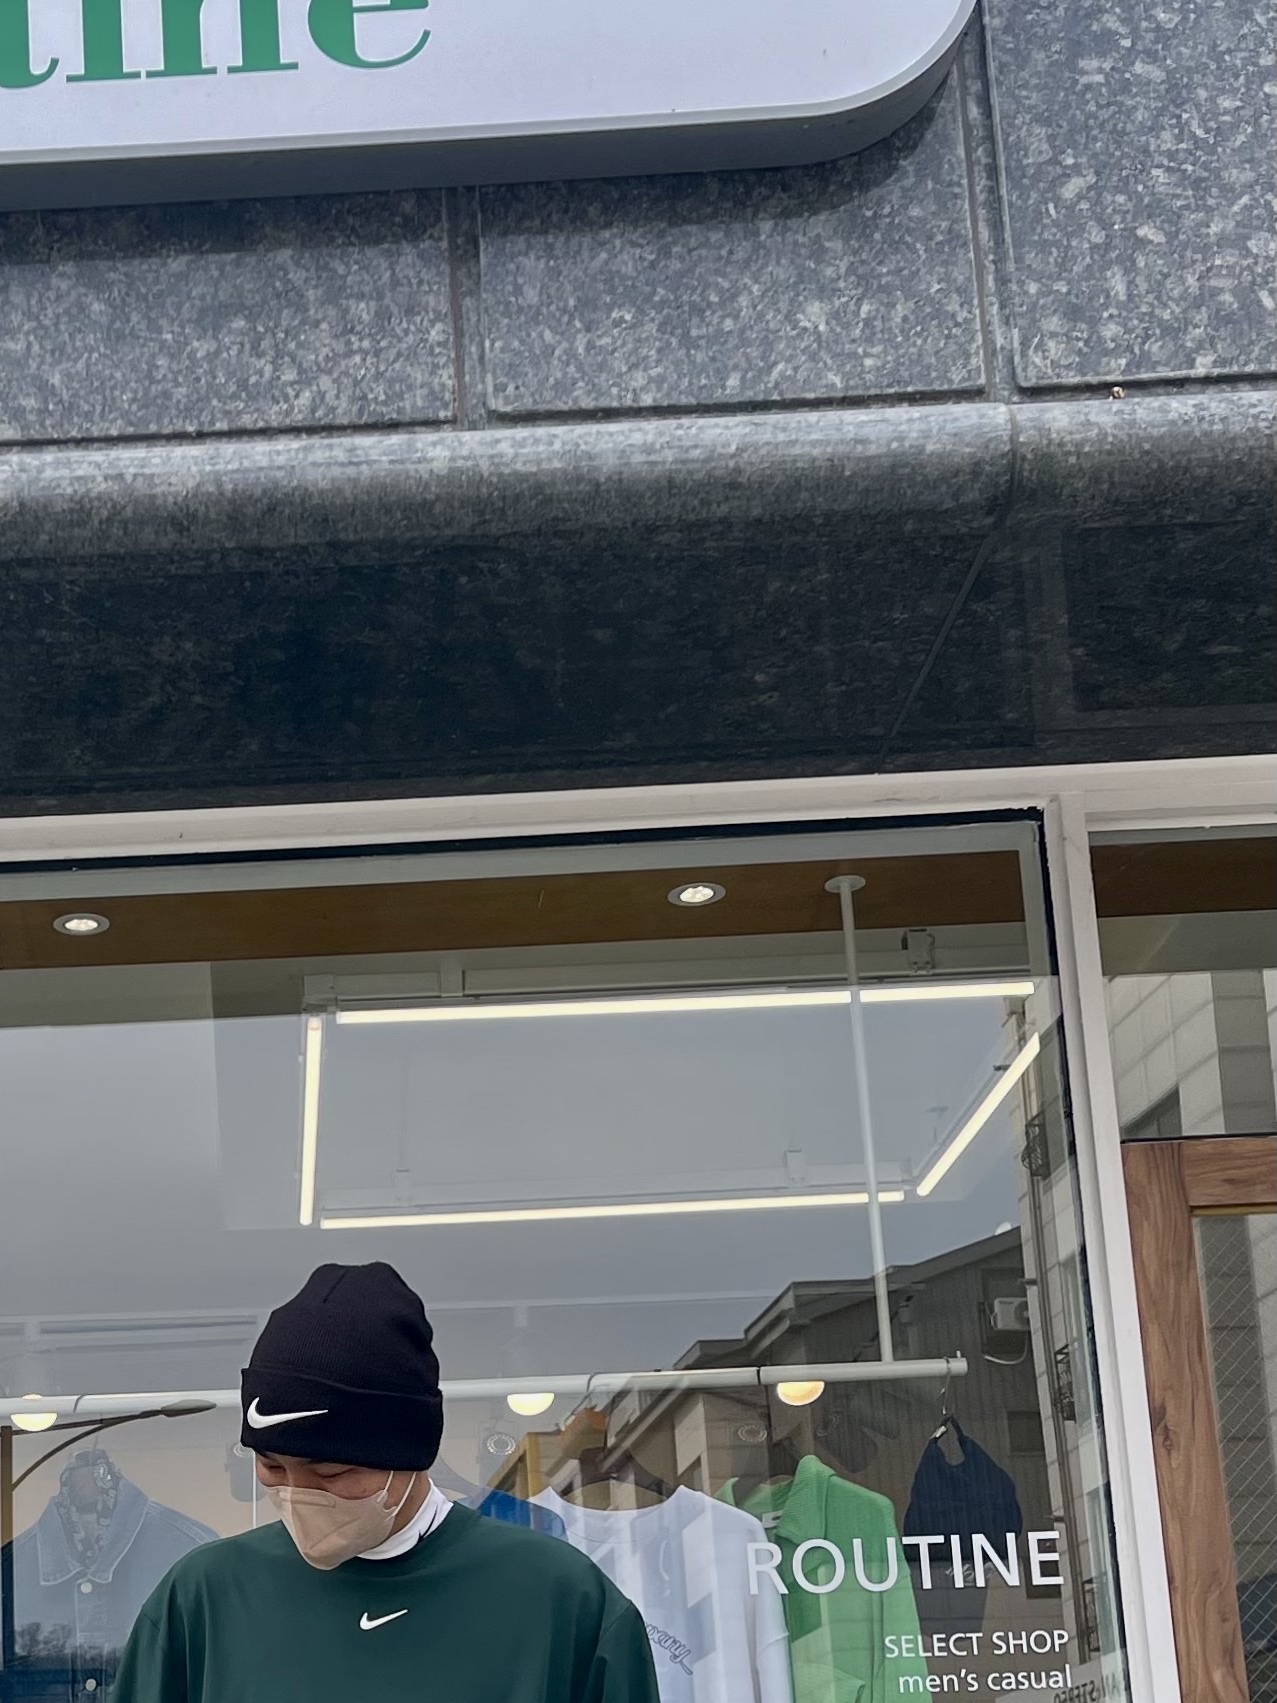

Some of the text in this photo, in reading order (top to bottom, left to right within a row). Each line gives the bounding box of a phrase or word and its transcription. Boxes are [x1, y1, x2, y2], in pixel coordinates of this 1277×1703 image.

[746, 1530, 1065, 1595] ROUTINE
[884, 1629, 1070, 1658] SELECT SHOP
[898, 1668, 979, 1693] men's
[986, 1664, 1072, 1690] casual
